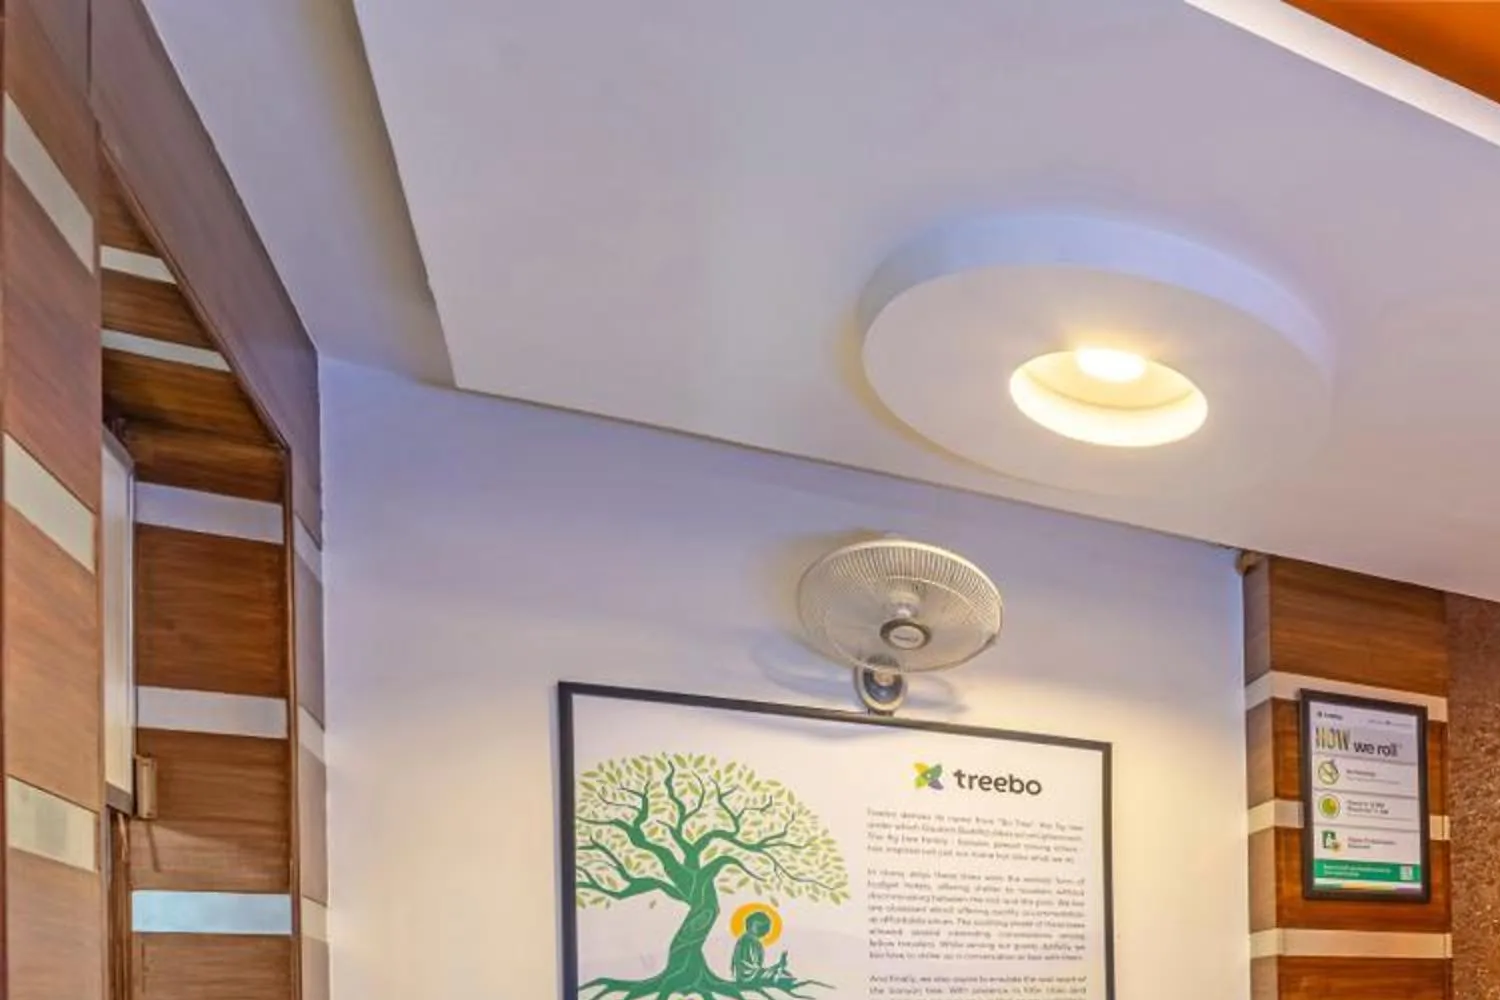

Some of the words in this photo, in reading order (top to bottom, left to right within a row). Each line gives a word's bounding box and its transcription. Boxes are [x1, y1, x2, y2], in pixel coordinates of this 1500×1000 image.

[1353, 742, 1375, 755] we
[1377, 743, 1399, 757] roll
[953, 769, 1043, 796] treebo
